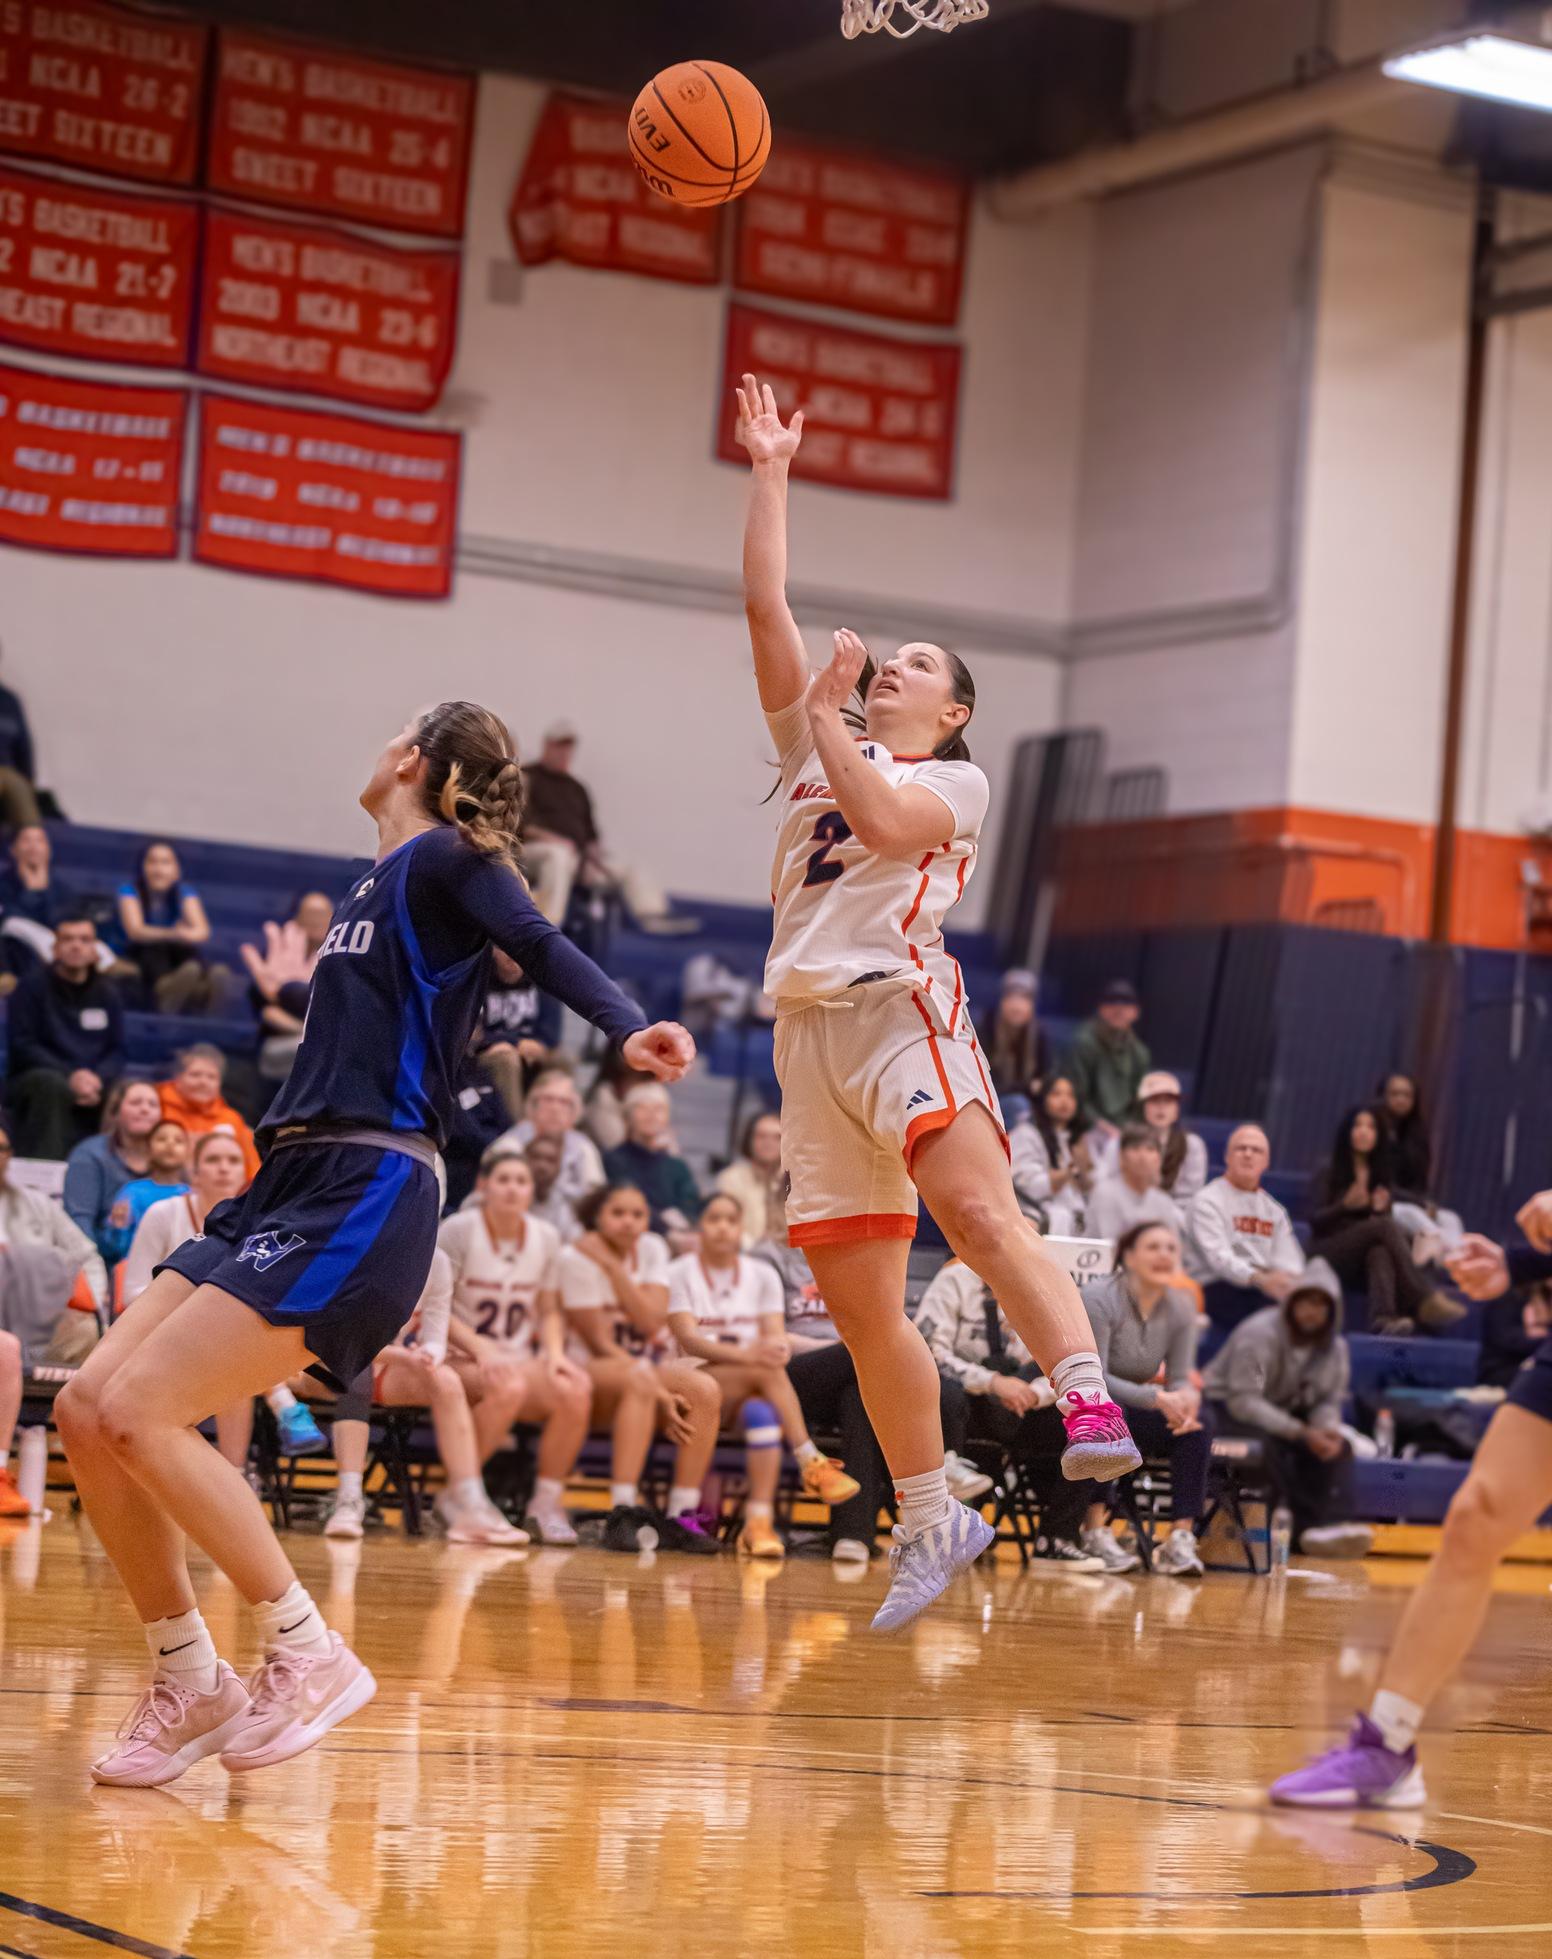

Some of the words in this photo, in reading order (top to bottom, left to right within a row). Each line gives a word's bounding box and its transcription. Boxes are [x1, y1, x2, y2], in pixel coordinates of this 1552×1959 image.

[32, 7, 194, 71] BASKETBALL
[30, 52, 100, 98] NCAA
[304, 63, 457, 124] BASKETBALL
[54, 109, 172, 164] SIXTEEN
[301, 112, 372, 155] NCAA
[233, 147, 317, 191] SWEET
[334, 166, 441, 215] SIXTEEN
[34, 198, 171, 254] BASKETBALL
[30, 247, 97, 288] NCAA
[72, 302, 177, 346] REGIONAL
[297, 291, 359, 333] NCAA
[802, 811, 853, 888] 2
[475, 1300, 526, 1338] 20
